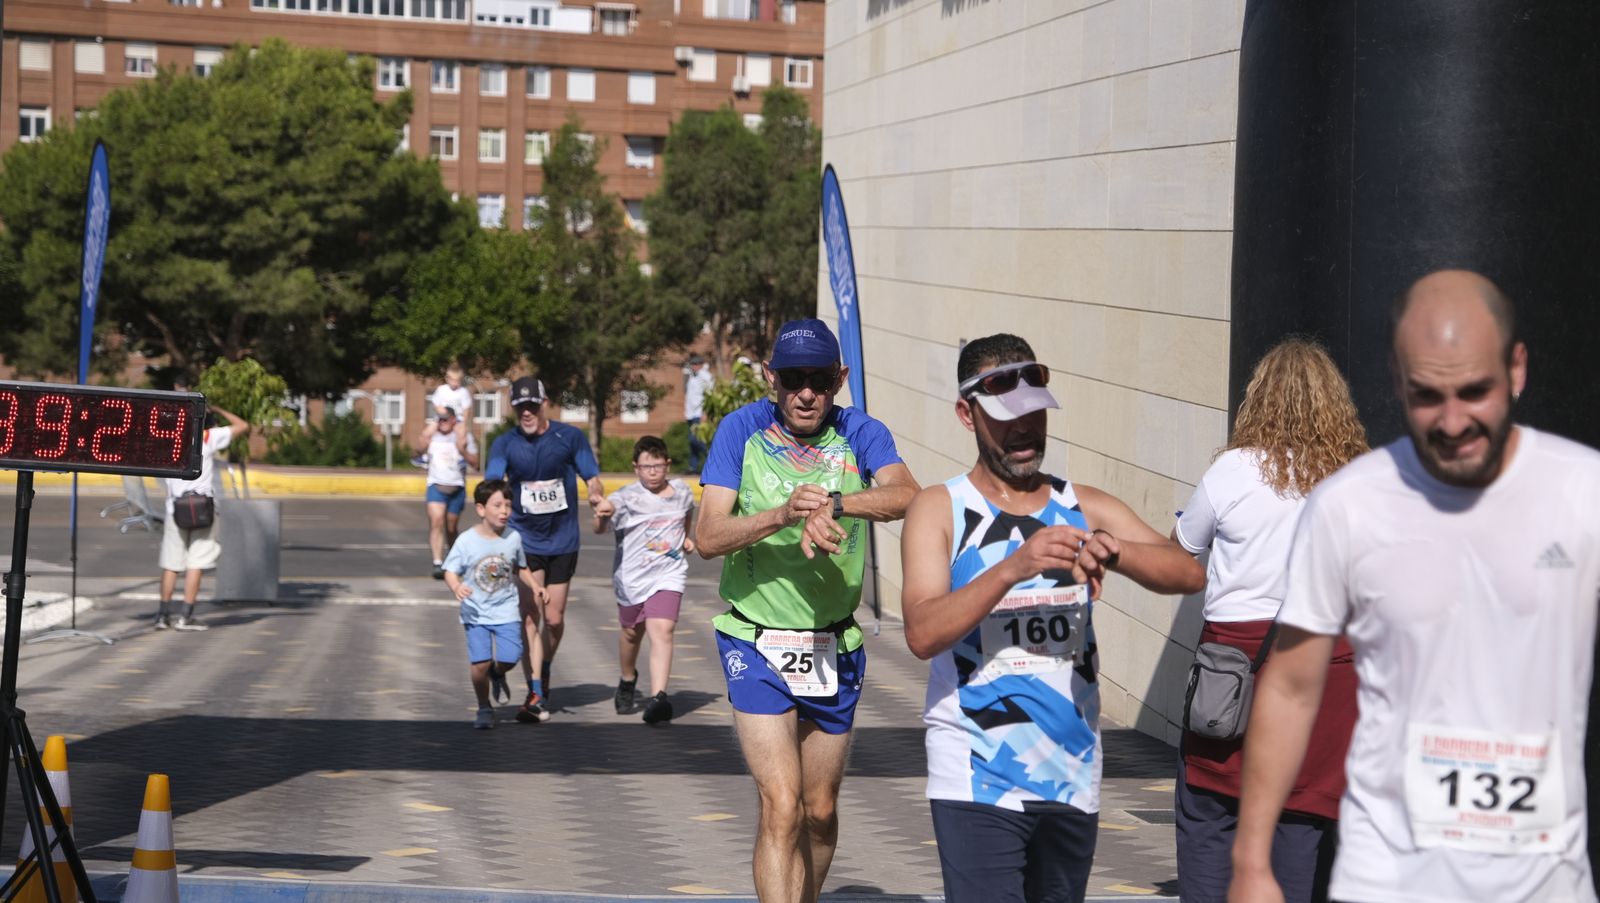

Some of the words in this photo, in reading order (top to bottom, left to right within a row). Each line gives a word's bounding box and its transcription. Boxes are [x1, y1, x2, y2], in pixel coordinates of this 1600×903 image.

[781, 329, 816, 341] TERUEL
[530, 491, 557, 502] 168
[1003, 614, 1070, 646] 160
[779, 652, 813, 674] 25
[1438, 769, 1537, 812] 132
